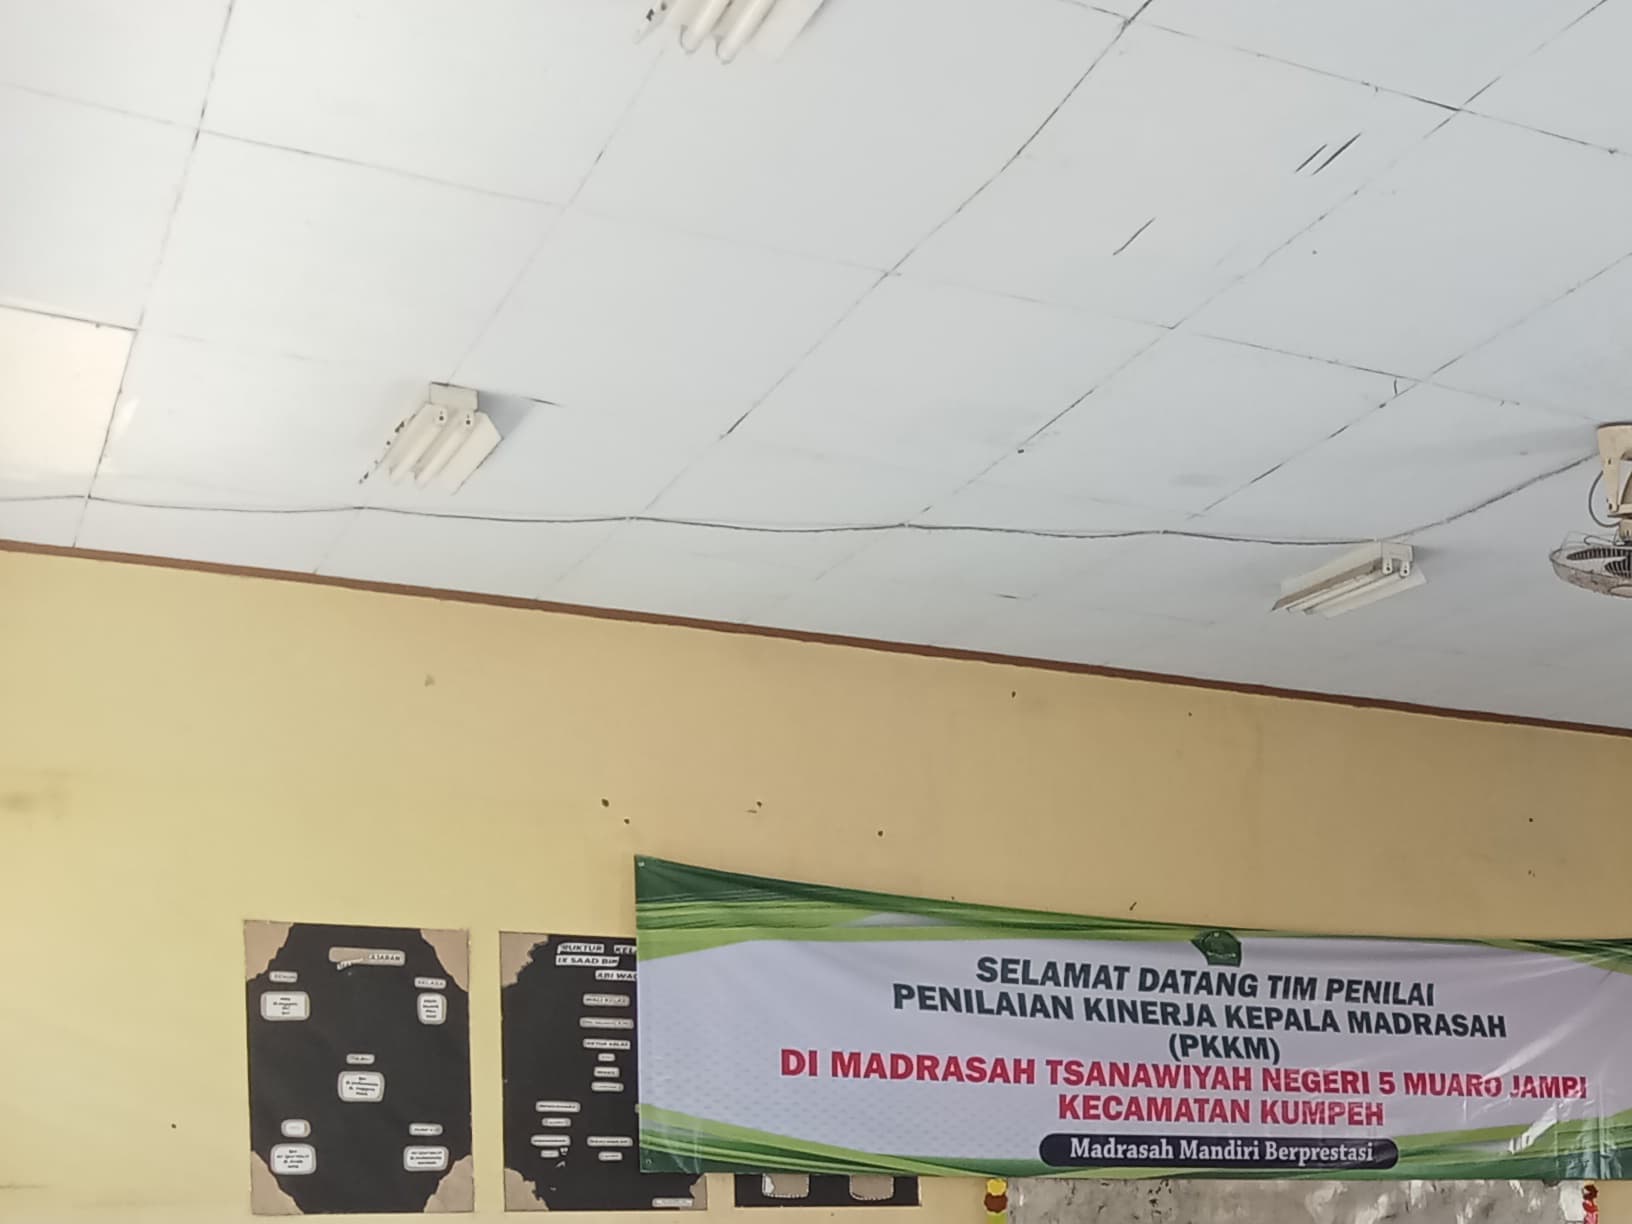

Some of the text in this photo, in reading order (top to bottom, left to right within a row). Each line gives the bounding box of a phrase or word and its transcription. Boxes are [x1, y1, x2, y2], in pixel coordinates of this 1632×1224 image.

[975, 955, 1435, 1007] SELAMAT DATANG TIM PENILAI
[892, 982, 1508, 1039] PENILAIAN KINERJA KEPALA MADRASAH
[1168, 1033, 1281, 1065] (PKKM)
[780, 1047, 1588, 1100] DI MADRASAH TSANAWIYAH NEGERI 5 MUARO JAMBI
[1058, 1093, 1385, 1127] KECAMATAN KUMPEH
[1070, 1136, 1374, 1168] Madrasah Mandiri Berprestasi
